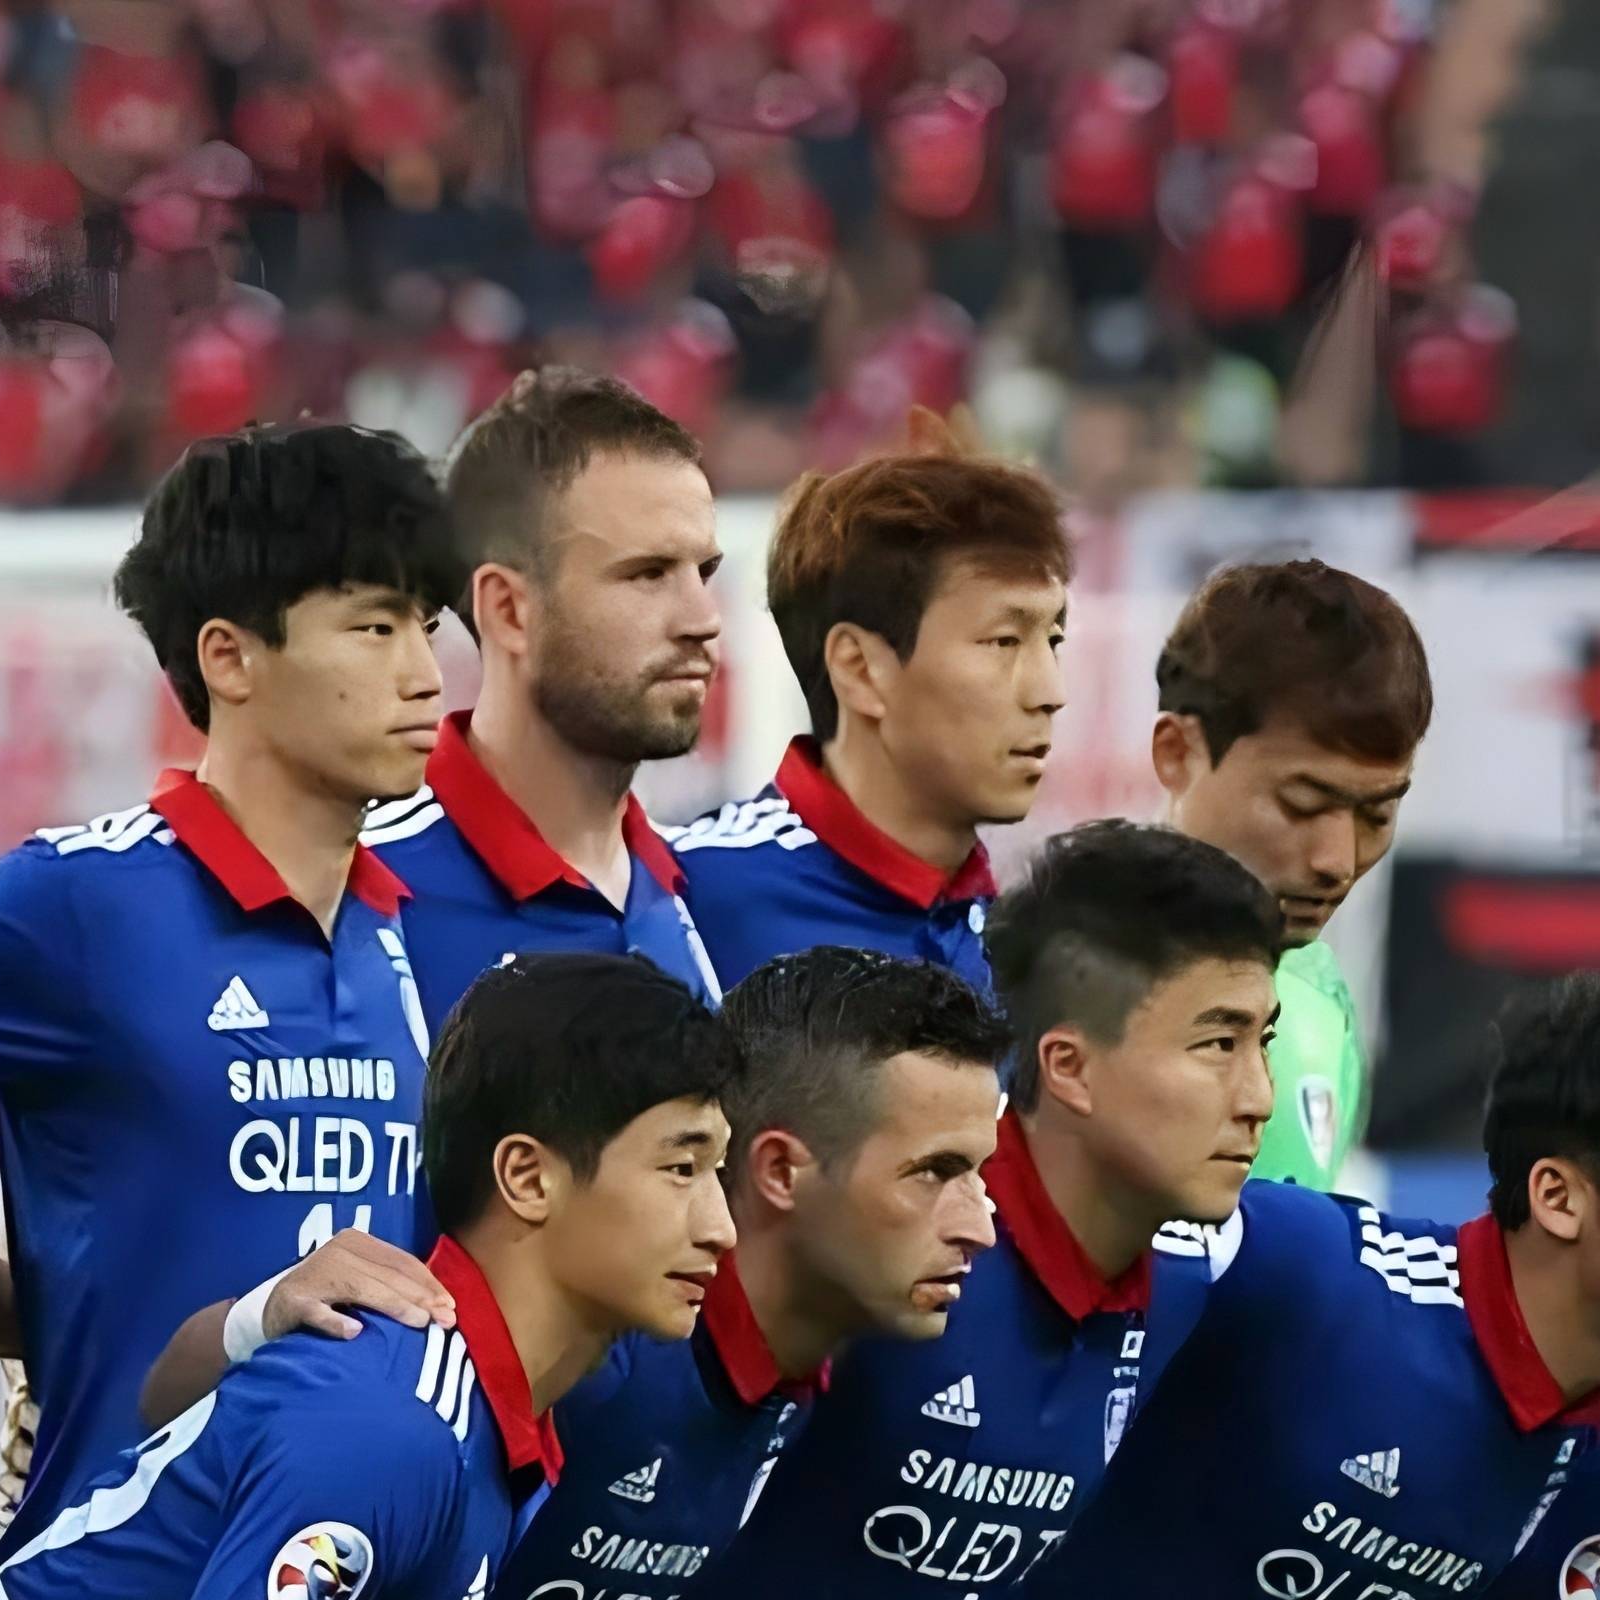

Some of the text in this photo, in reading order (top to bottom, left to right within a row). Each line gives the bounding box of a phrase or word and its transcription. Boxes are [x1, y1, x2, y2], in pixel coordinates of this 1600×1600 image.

[228, 1057, 396, 1103] SAMSUNG
[229, 1116, 375, 1193] QLED
[900, 1449, 1076, 1512] SAMSUNG
[864, 1505, 1021, 1582] QLED
[1302, 1502, 1484, 1592] SAMSUNG
